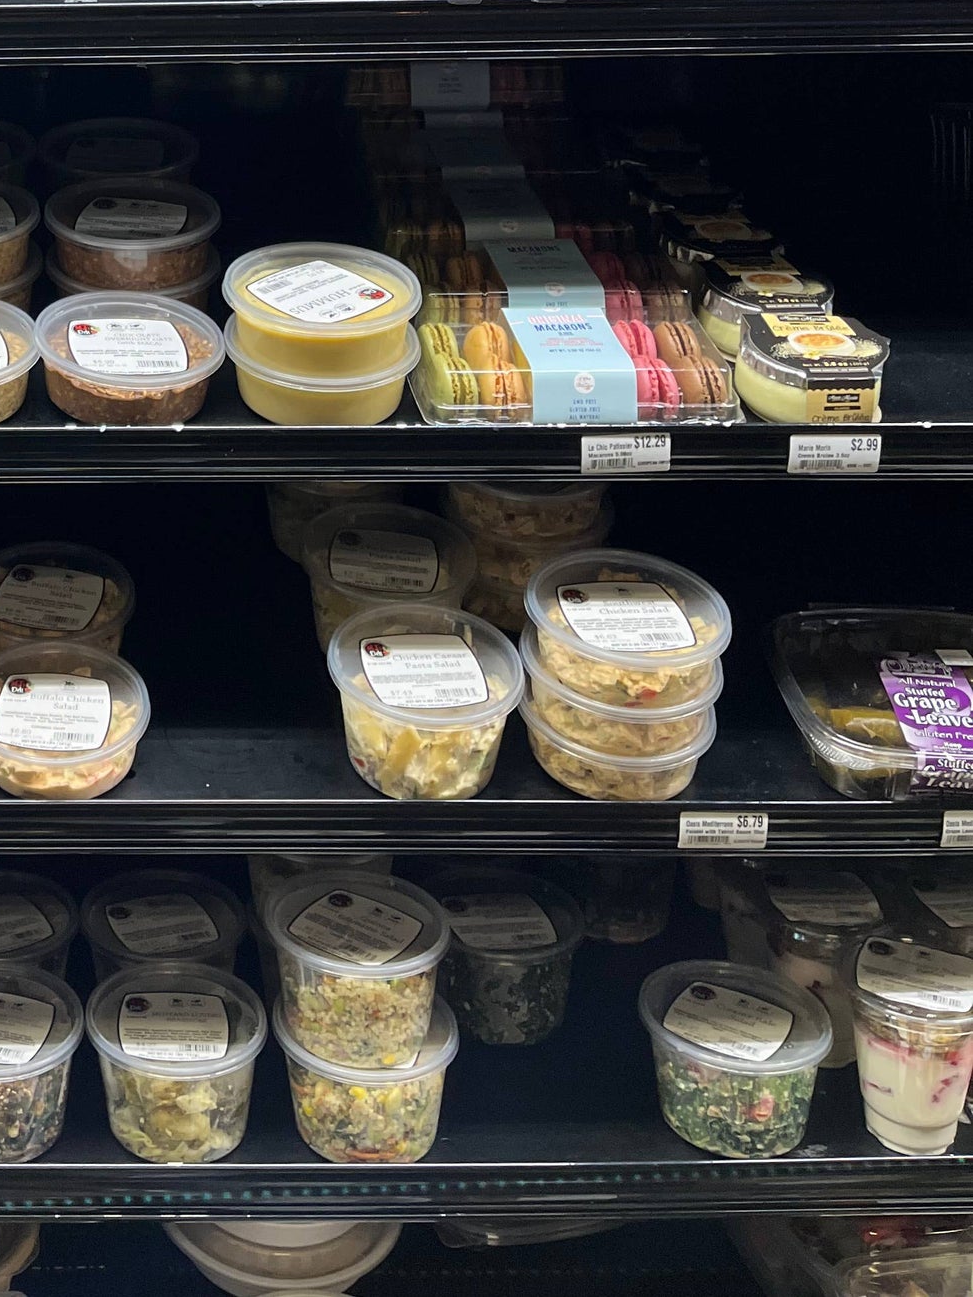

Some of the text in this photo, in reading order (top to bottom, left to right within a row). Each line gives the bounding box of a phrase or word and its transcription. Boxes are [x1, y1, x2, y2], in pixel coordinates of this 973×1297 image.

[289, 289, 352, 314] HUMMUS
[534, 323, 593, 331] MACARONS
[634, 435, 666, 449] $12.29
[851, 438, 877, 452] $2.99
[598, 606, 670, 614] Chicken Salad
[433, 660, 461, 668] Salad
[915, 678, 956, 687] Natural
[905, 687, 945, 697] Stuffed
[30, 694, 104, 703] Buffalo Chicken
[894, 692, 956, 712] Grape
[53, 703, 78, 711] Salad
